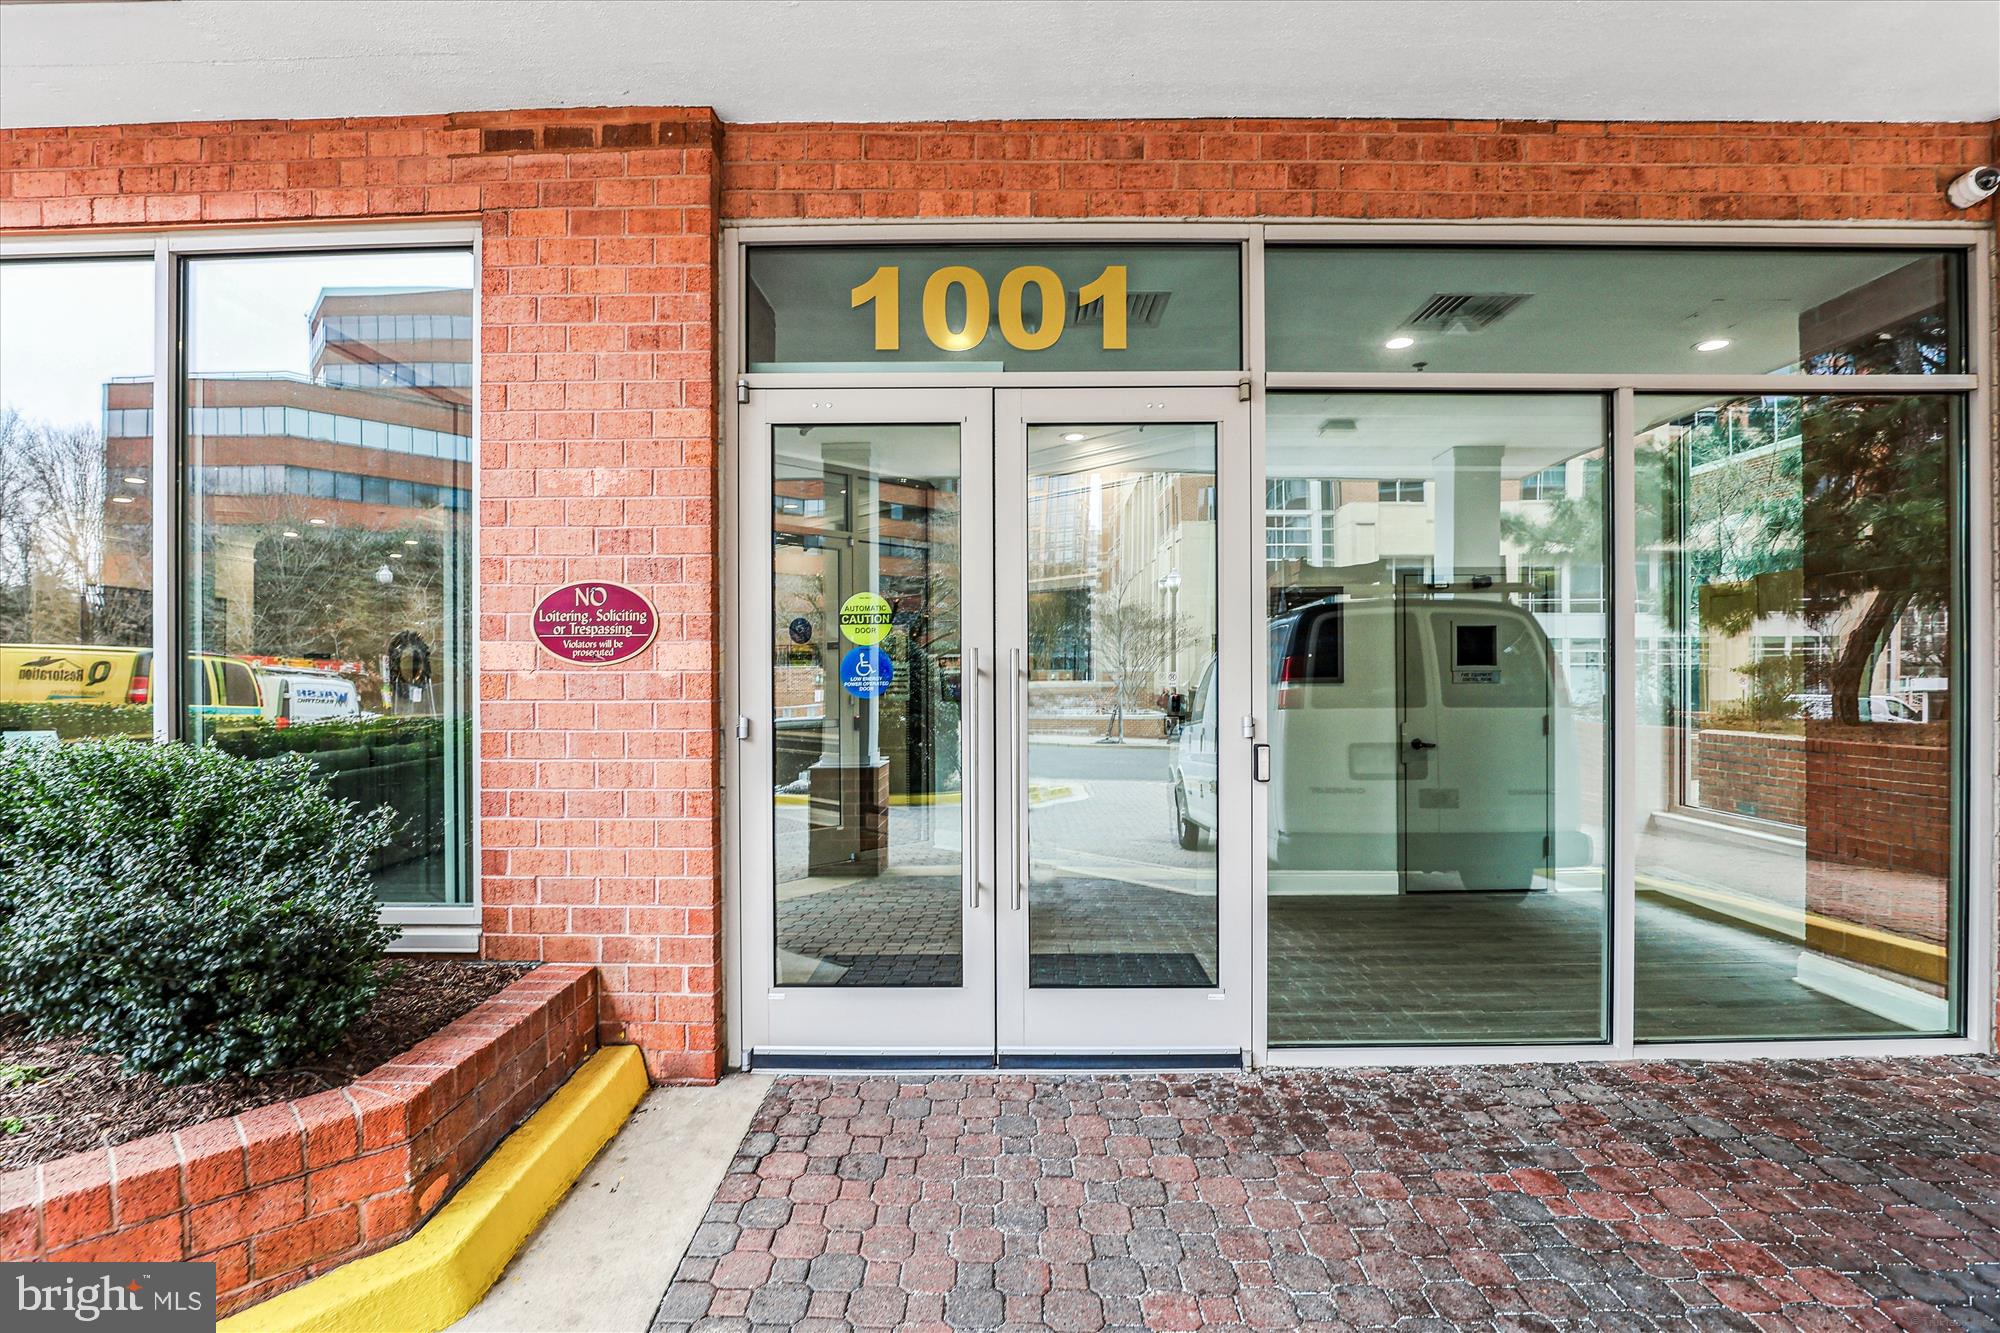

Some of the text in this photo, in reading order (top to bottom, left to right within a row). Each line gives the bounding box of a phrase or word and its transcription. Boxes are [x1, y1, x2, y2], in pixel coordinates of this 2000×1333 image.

[851, 265, 1127, 351] 1001
[575, 587, 608, 607] NO
[539, 609, 647, 624] Loitering, Soliciting
[841, 614, 890, 624] CAUTION
[553, 622, 633, 637] or Trespassing
[563, 640, 624, 648] Violators will be
[572, 648, 614, 658] prosecuted
